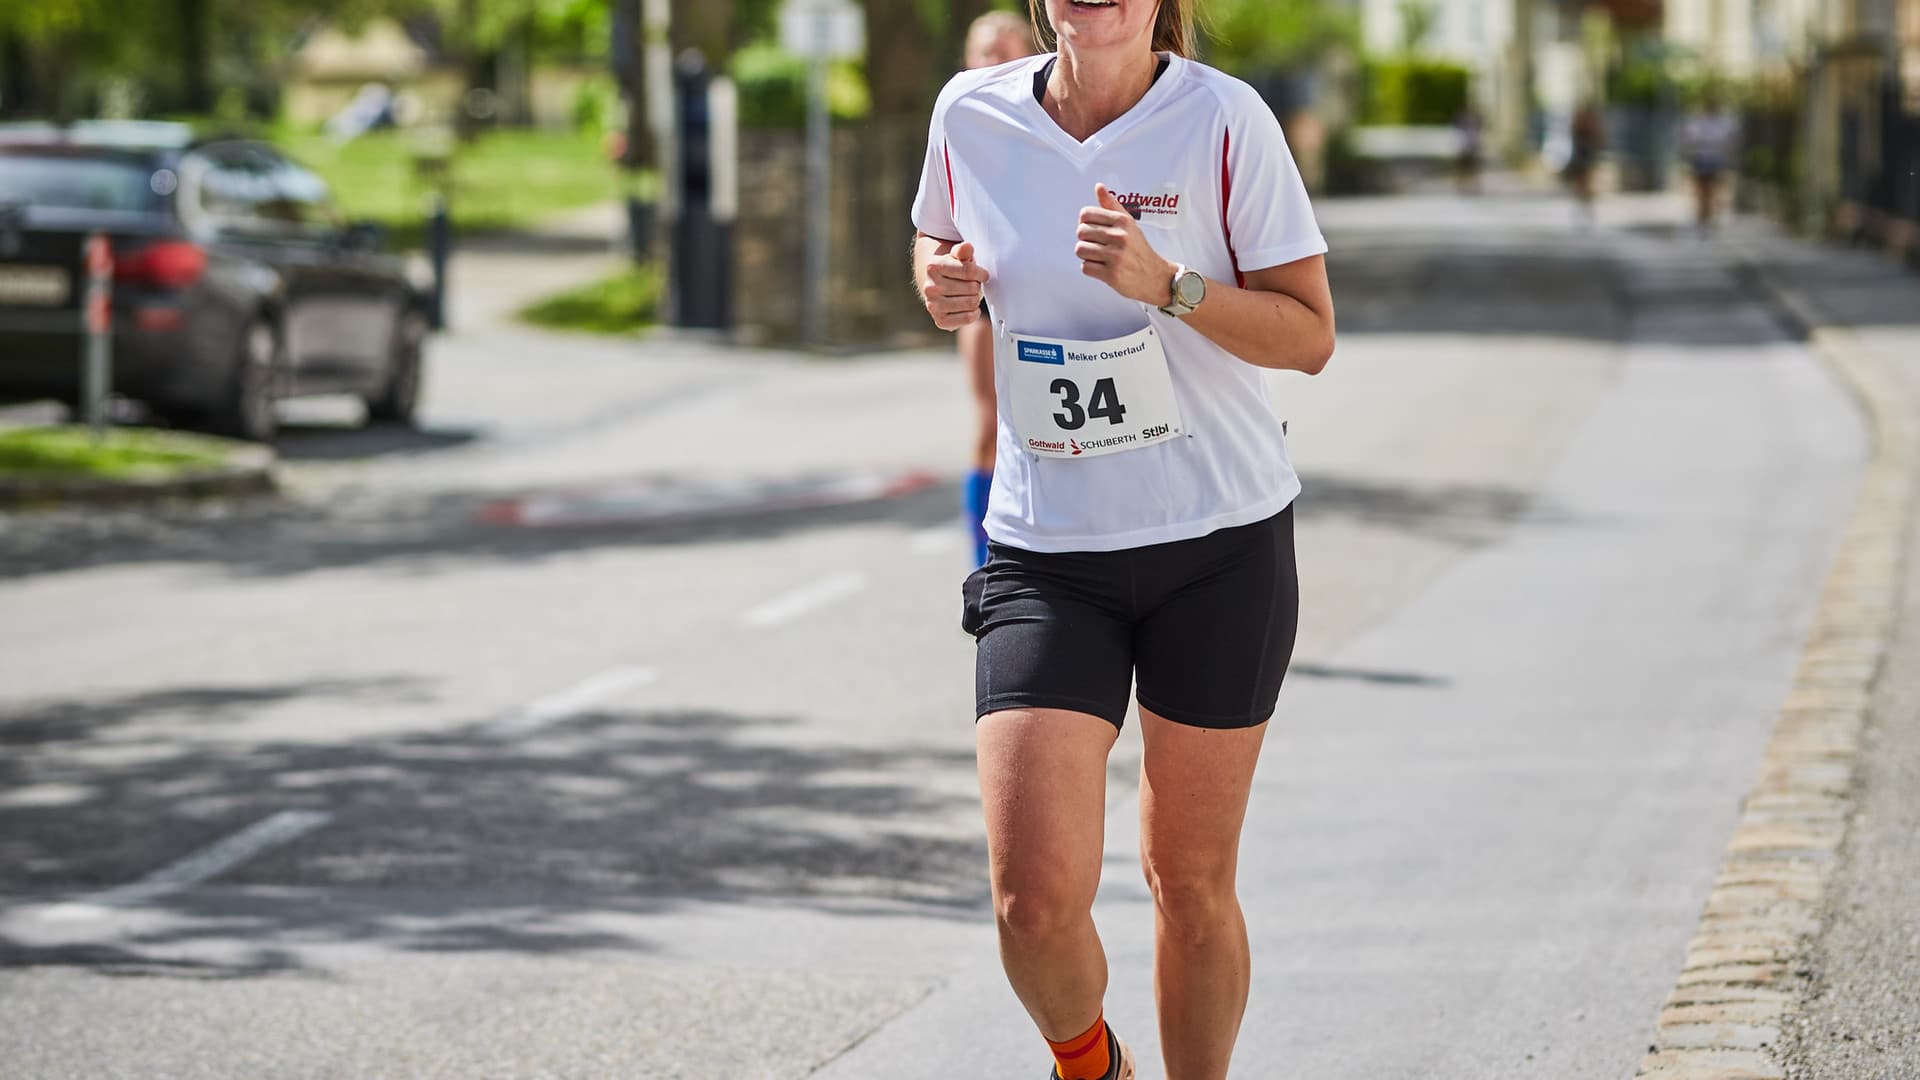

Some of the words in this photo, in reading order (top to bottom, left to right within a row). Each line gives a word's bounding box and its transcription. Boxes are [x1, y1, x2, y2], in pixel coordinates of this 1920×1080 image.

[1067, 351, 1098, 361] Melker
[1100, 342, 1146, 360] Osterlauf
[1050, 377, 1126, 430] 34
[1028, 438, 1065, 449] Gottwald
[1080, 434, 1136, 449] SCHUBERTH
